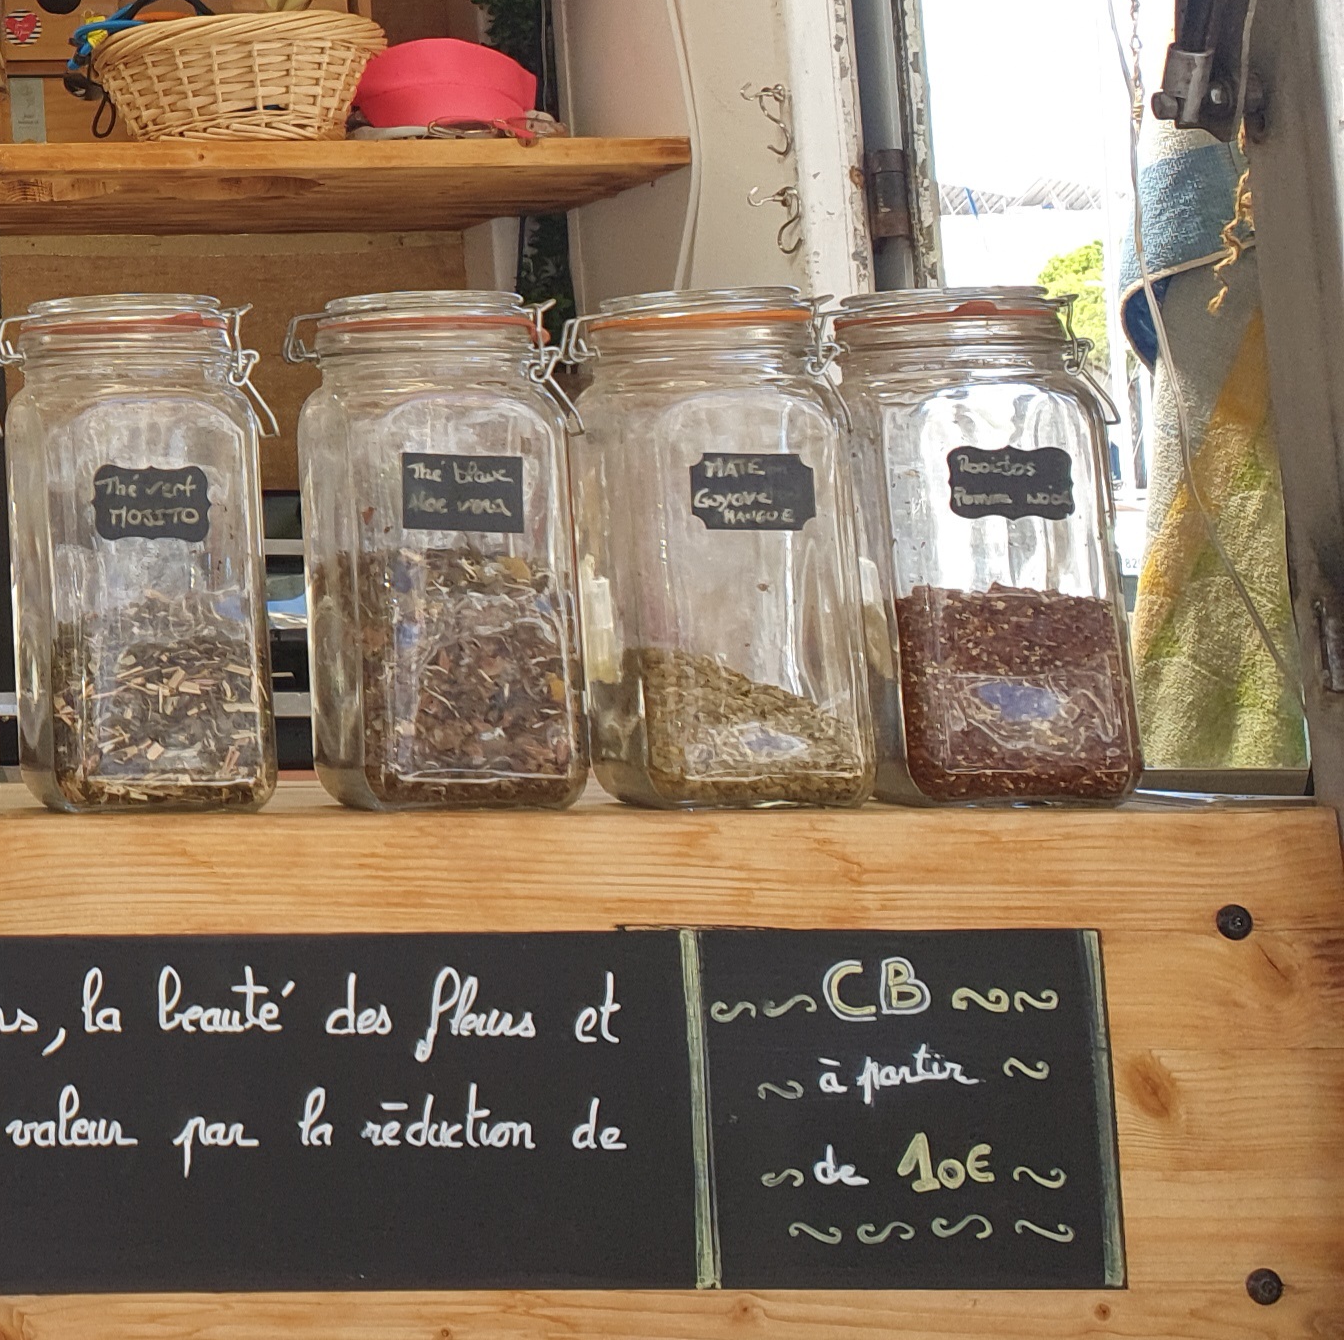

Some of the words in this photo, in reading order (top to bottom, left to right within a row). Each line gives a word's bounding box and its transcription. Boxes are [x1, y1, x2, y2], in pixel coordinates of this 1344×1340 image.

[82, 966, 124, 1035] la
[157, 965, 296, 1035] beauté
[325, 972, 393, 1038] des
[413, 965, 536, 1063] fleurs
[574, 971, 621, 1045] et
[822, 956, 932, 1023] CB
[816, 1056, 848, 1094] à
[855, 1042, 982, 1106] partir
[6, 1083, 138, 1149] valeur
[172, 1116, 260, 1179] par
[298, 1086, 334, 1147] la
[361, 1082, 536, 1150] réduction
[571, 1097, 627, 1151] de
[813, 1144, 870, 1187] de
[896, 1131, 996, 1193] 10€
